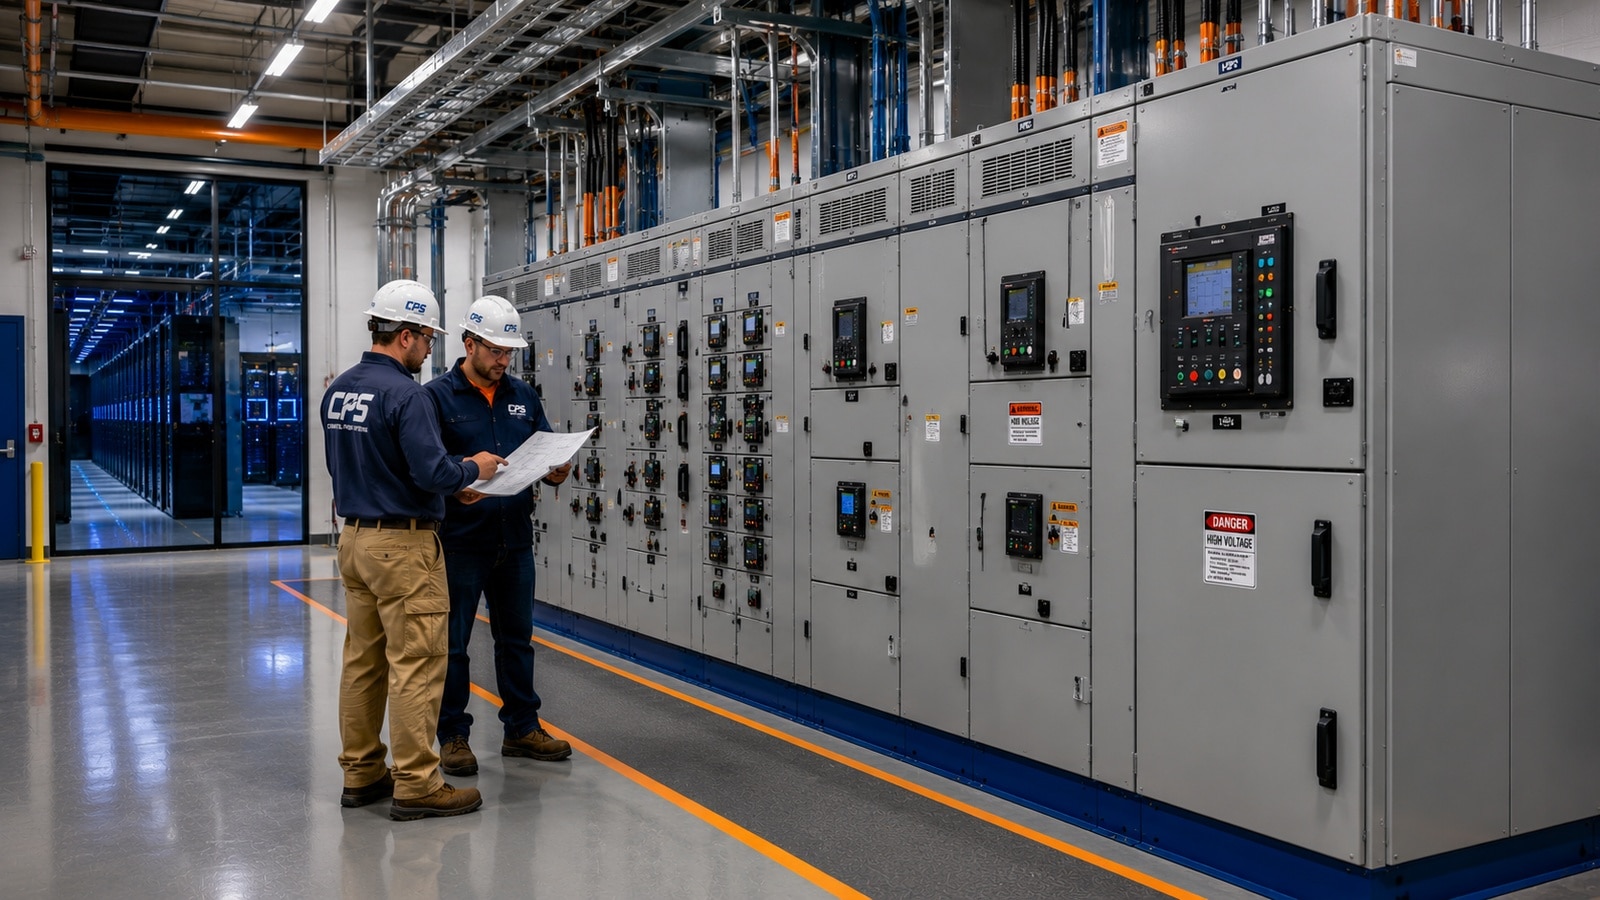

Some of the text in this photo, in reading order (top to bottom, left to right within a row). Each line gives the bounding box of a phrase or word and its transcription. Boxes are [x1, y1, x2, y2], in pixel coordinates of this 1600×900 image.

[405, 301, 427, 313] CPS
[327, 391, 375, 423] CPS
[508, 404, 526, 413] CPS
[1213, 516, 1248, 530] DANGER
[1206, 534, 1253, 549] HIGH VOLTAGE
